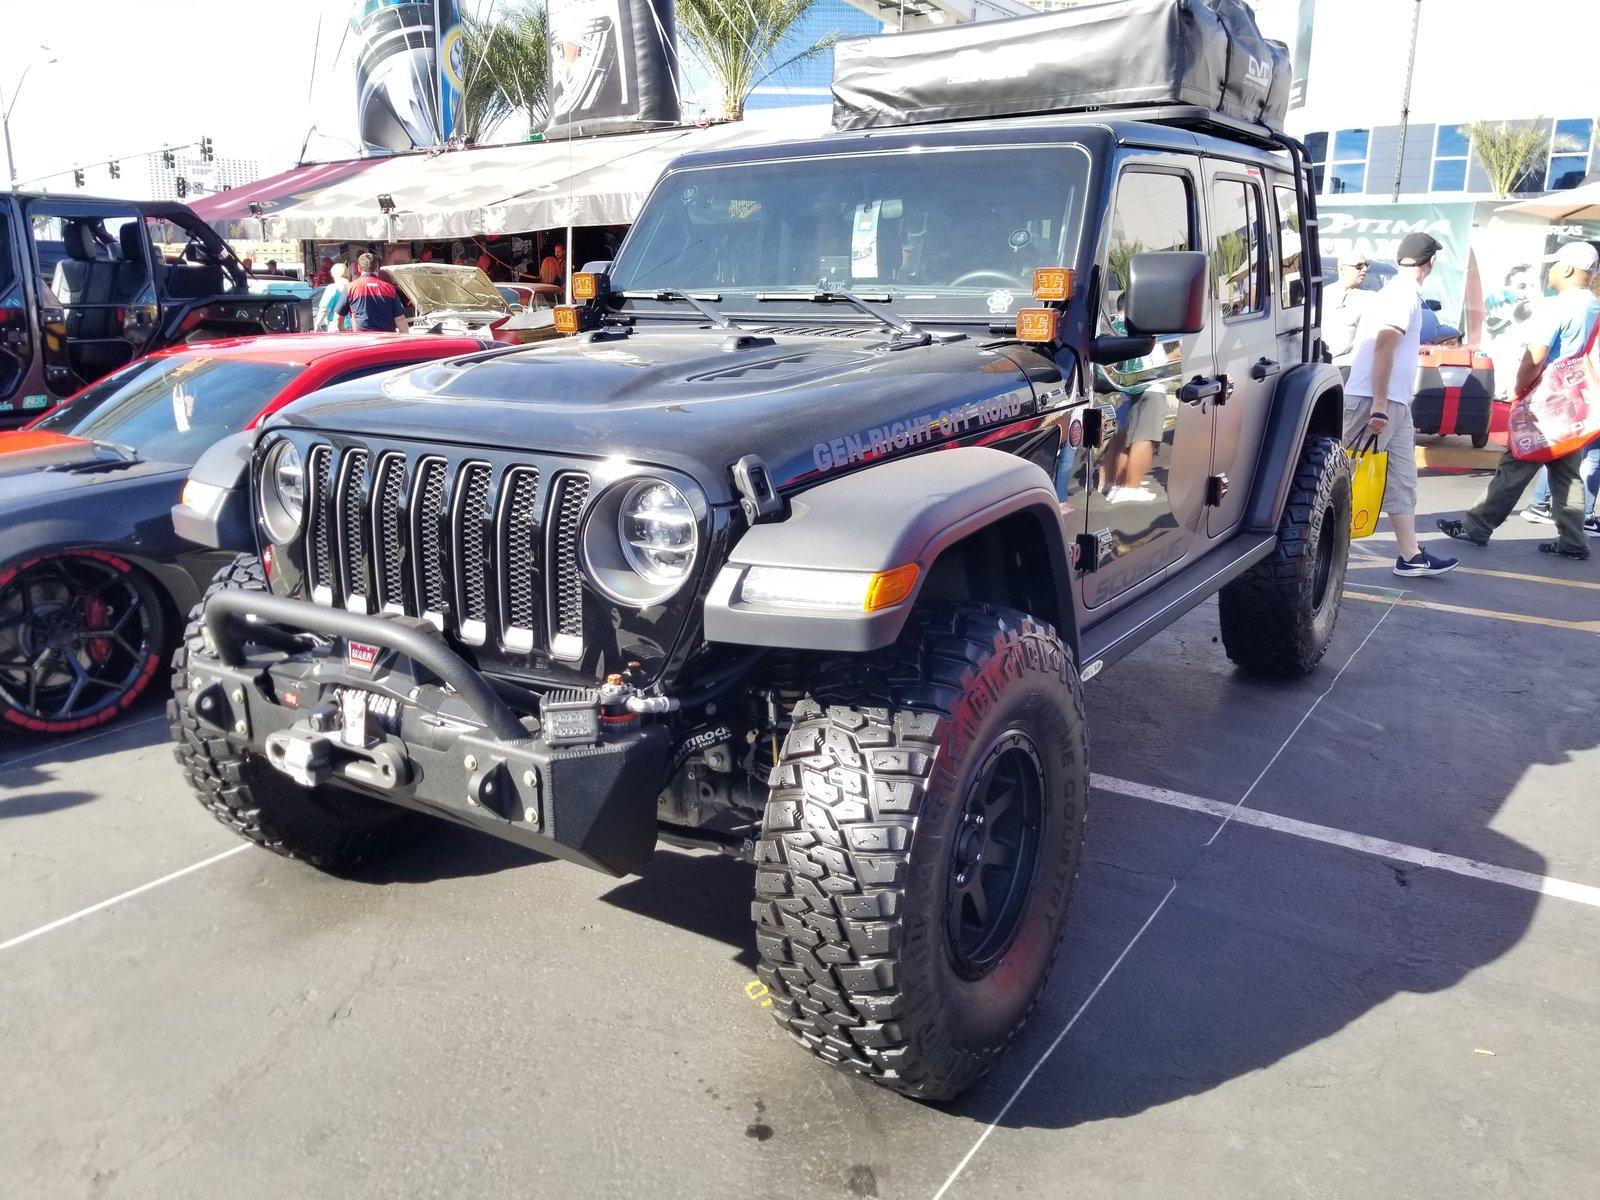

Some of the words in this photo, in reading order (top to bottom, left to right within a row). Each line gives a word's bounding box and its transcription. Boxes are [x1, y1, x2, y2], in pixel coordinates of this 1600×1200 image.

[1317, 212, 1451, 235] OPTIMA
[812, 414, 934, 472] GEN-RIGHT
[938, 403, 977, 434] OFF
[976, 392, 1021, 426] ROAD
[351, 648, 374, 662] WARN
